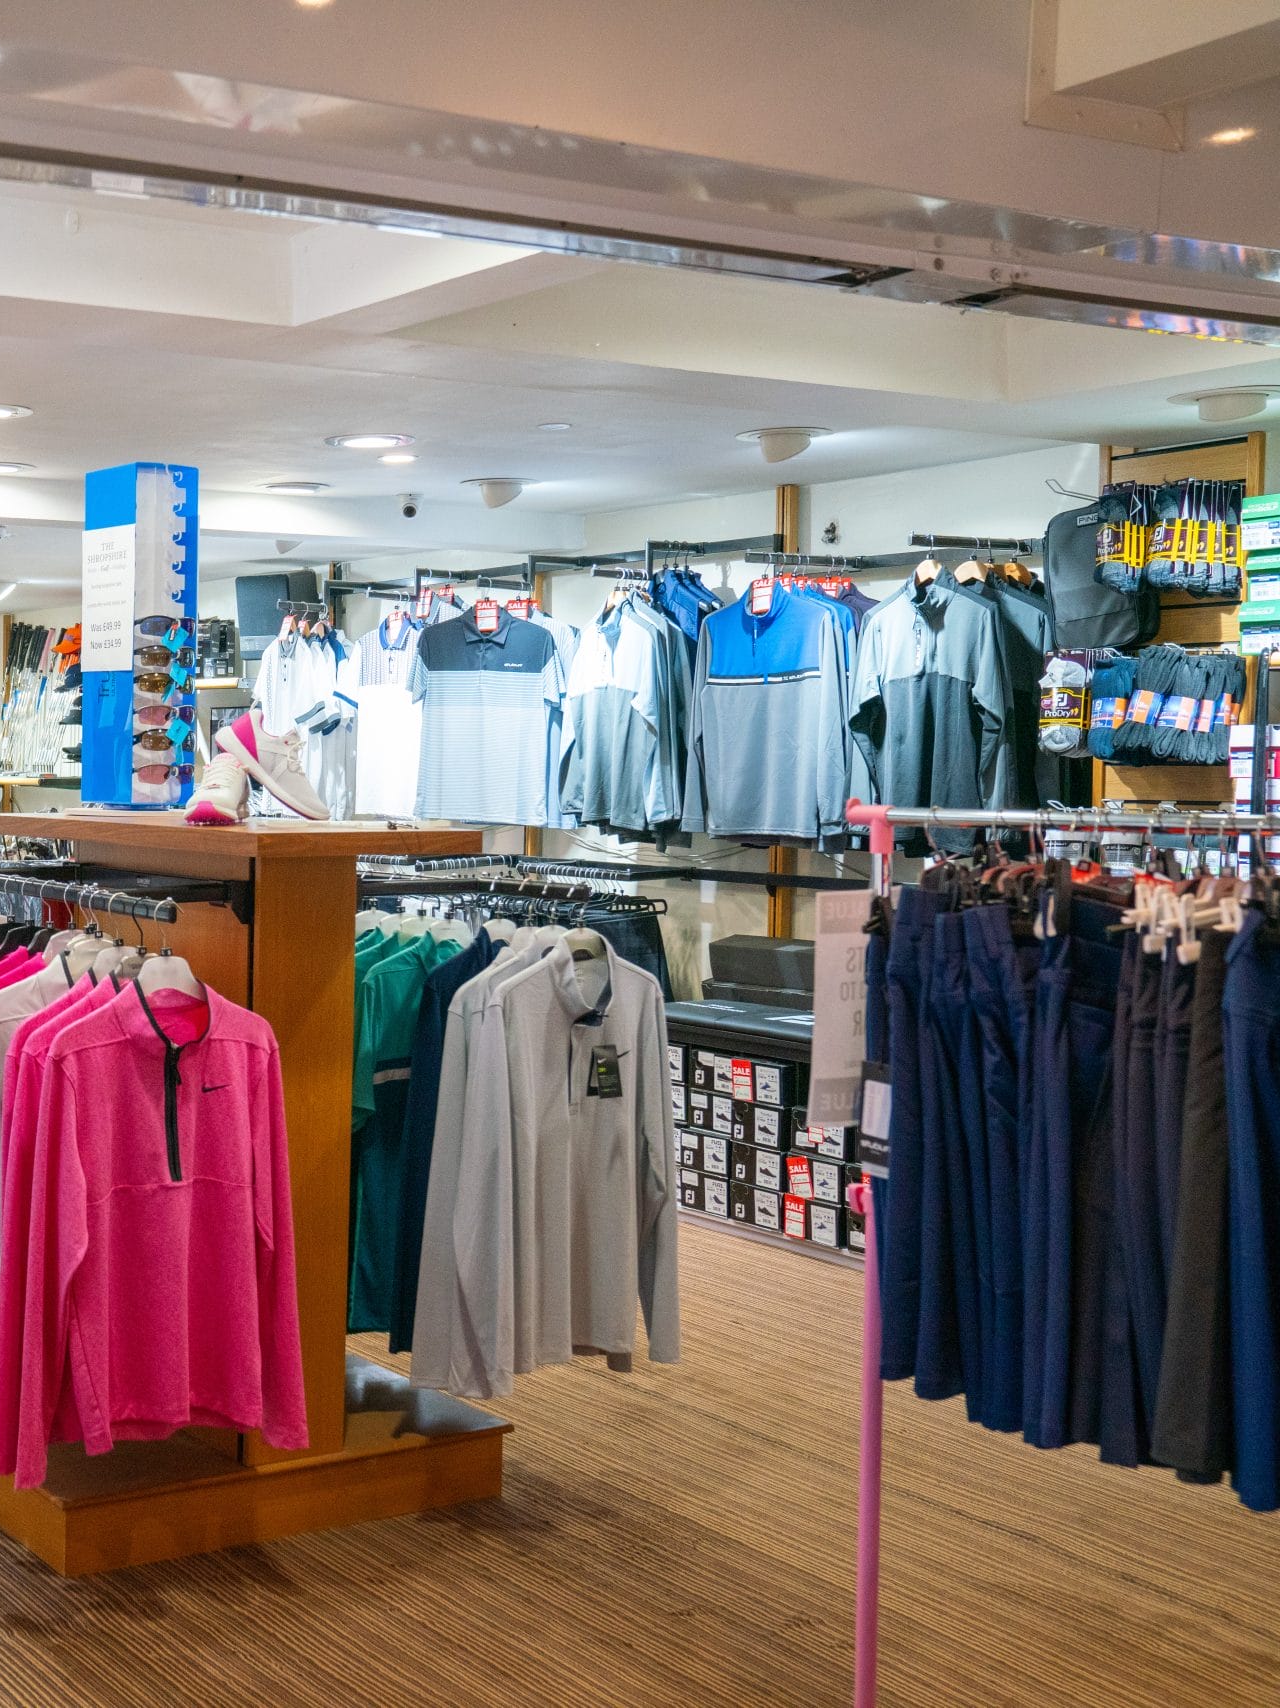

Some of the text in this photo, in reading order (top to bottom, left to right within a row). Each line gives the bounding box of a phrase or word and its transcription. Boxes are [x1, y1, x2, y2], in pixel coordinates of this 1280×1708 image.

[753, 579, 773, 588] SALE
[91, 623, 102, 632] Was
[91, 640, 103, 650] Now
[1044, 709, 1071, 718] ProDry
[695, 1069, 704, 1084] FJ
[732, 1066, 751, 1076] SALE
[694, 1109, 703, 1124] FJ
[734, 1124, 744, 1139] FJ
[683, 1149, 693, 1165] FJ
[735, 1163, 745, 1179] FJ
[789, 1164, 808, 1174] SALE
[685, 1189, 695, 1204] FJ
[735, 1203, 745, 1218] FJ
[785, 1201, 804, 1212] SALE
